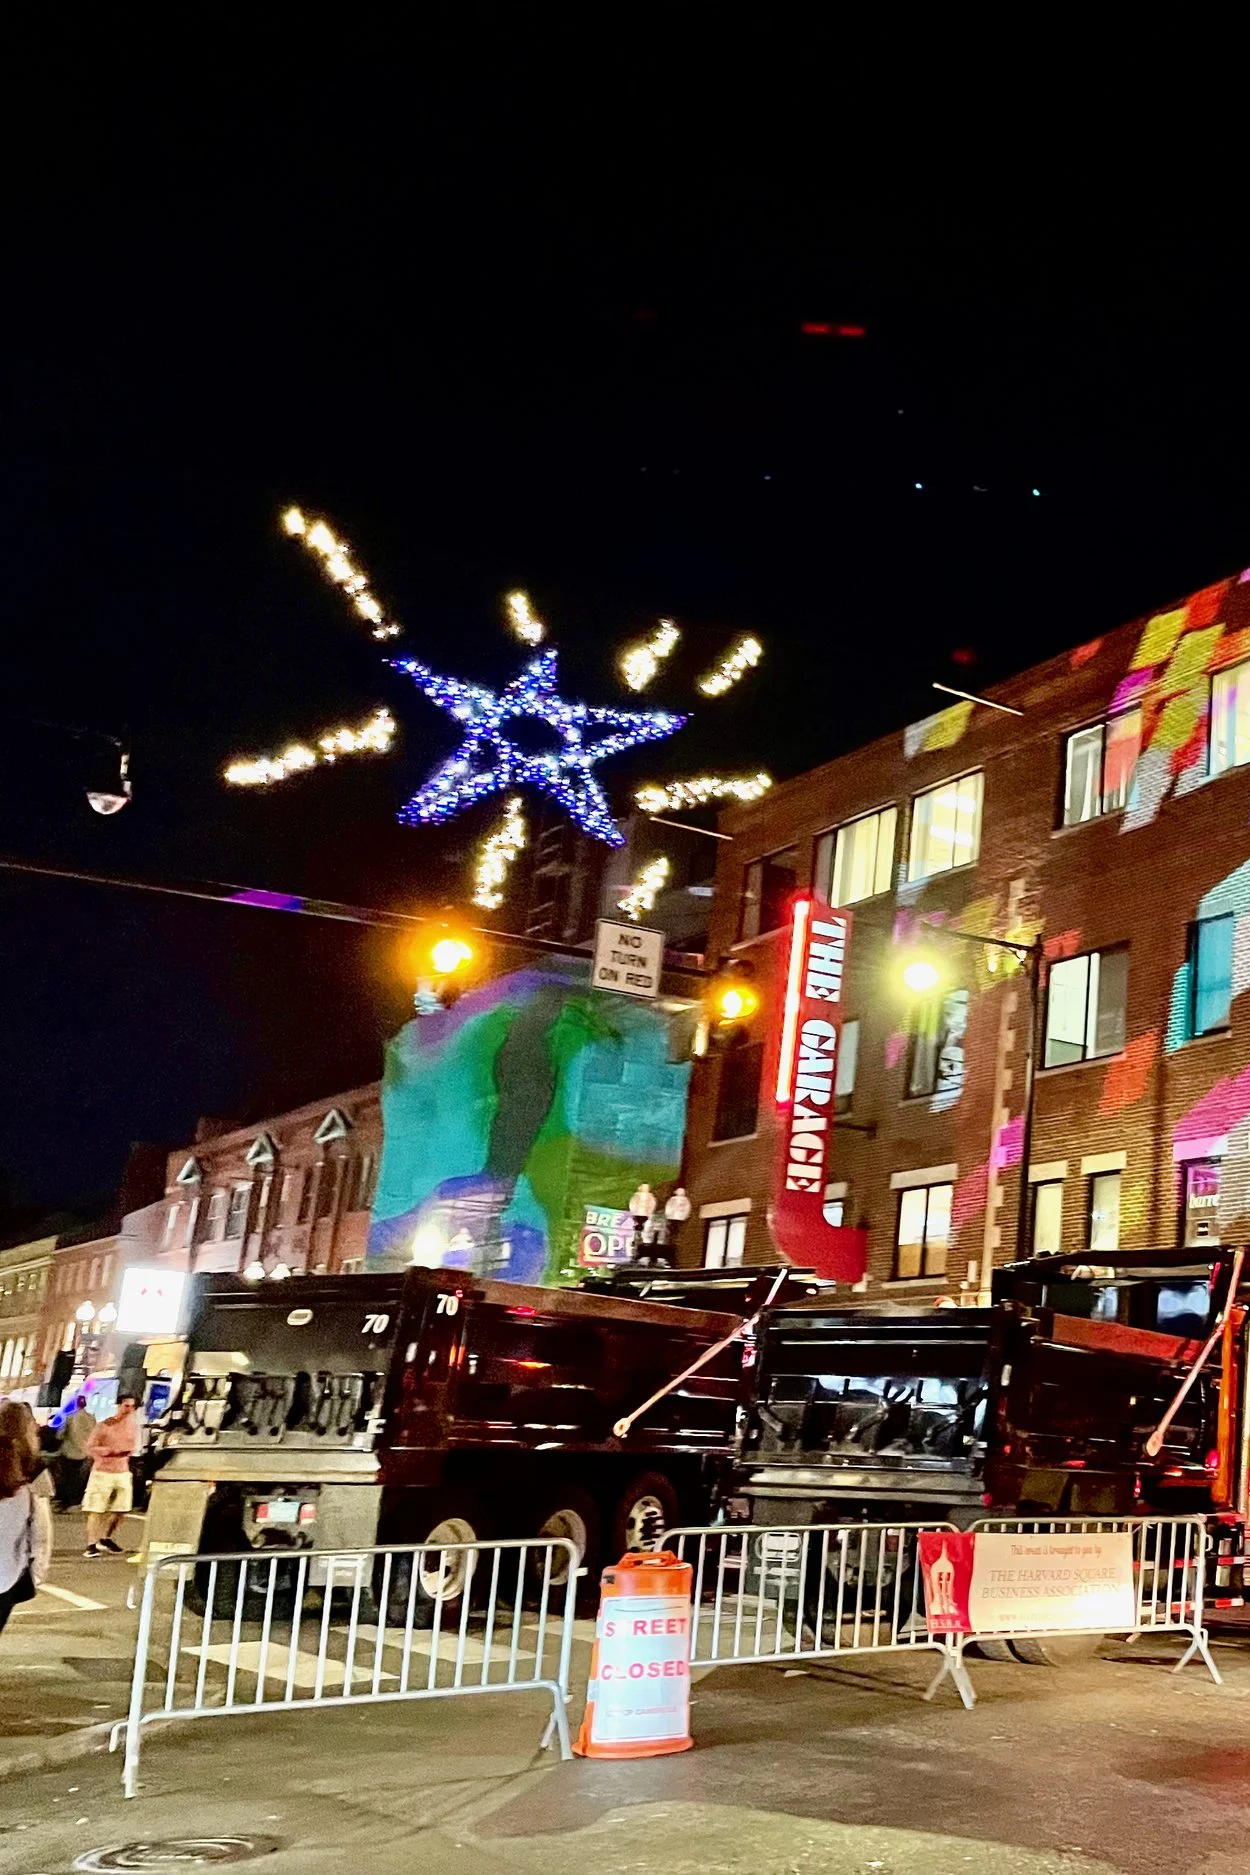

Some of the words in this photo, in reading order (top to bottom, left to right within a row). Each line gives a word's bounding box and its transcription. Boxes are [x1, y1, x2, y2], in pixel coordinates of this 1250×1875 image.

[618, 933, 643, 949] NO
[610, 949, 648, 968] TURN
[804, 916, 847, 1003] THE
[599, 966, 618, 982] ON
[625, 971, 653, 989] RED
[785, 1018, 837, 1193] GARAGE
[585, 1210, 637, 1230] BREA
[436, 1293, 459, 1316] 70
[361, 1314, 390, 1334] 70
[988, 1570, 1016, 1581] THE
[1017, 1568, 1071, 1581] HARVARD
[1073, 1567, 1117, 1583] SQUARE
[981, 1586, 1040, 1598] BUSINESS
[604, 1617, 687, 1637] SREET
